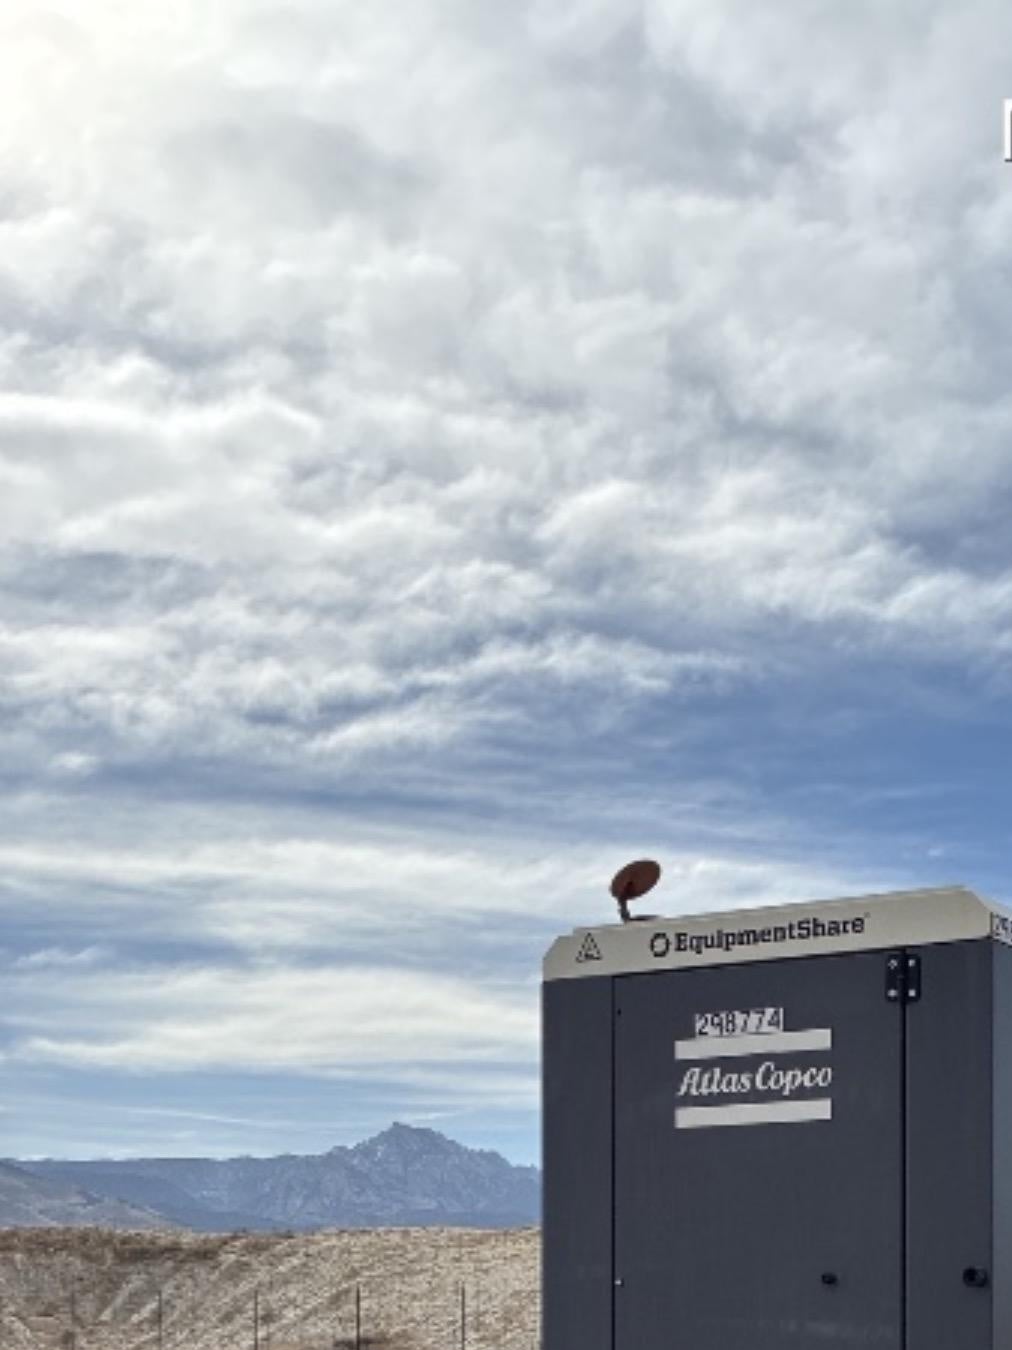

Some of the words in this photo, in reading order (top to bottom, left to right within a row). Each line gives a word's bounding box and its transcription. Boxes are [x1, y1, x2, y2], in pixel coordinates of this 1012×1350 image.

[673, 916, 865, 955] EquipmentShare
[697, 1008, 781, 1037] 298774
[677, 1062, 752, 1097] Atlas
[754, 1060, 833, 1097] Copco
